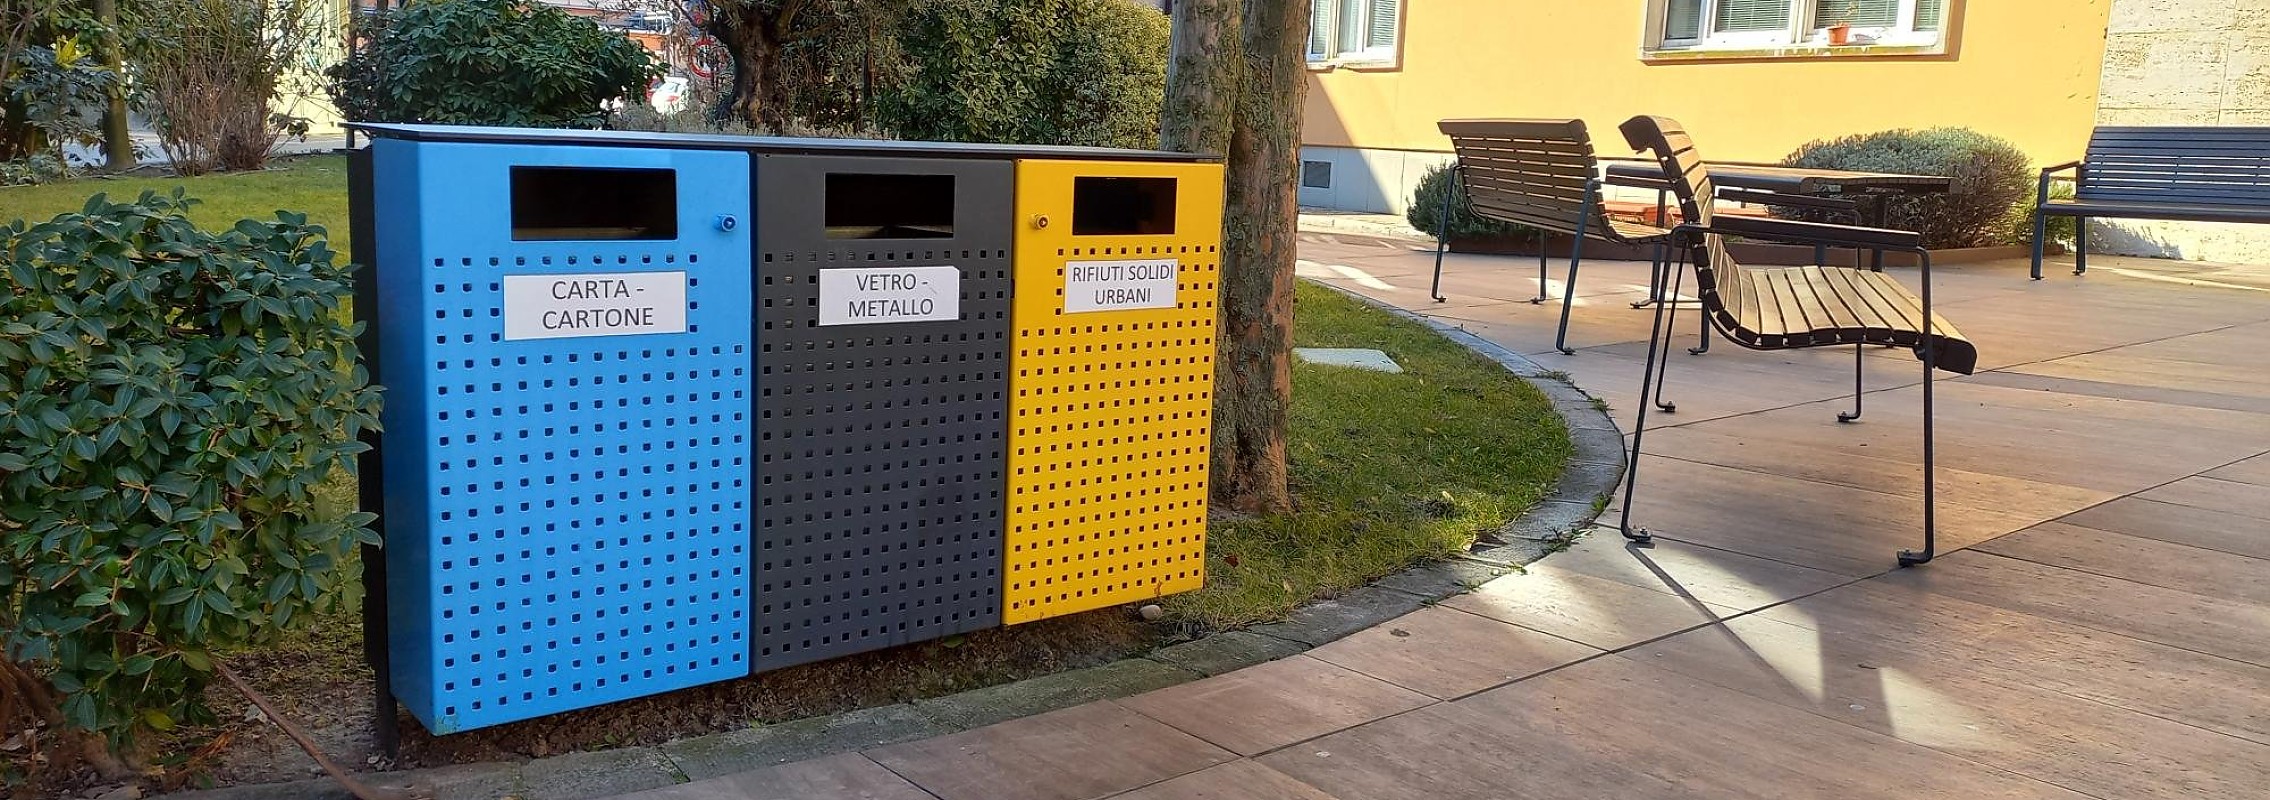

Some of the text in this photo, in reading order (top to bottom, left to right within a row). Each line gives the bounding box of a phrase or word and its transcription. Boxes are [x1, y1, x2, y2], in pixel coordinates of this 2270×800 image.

[855, 274, 917, 291] VETRO
[1073, 265, 1174, 282] RIFIUTI SOLIDI
[551, 280, 630, 300] CARTA
[1095, 288, 1151, 305] URBANI
[848, 298, 934, 318] METALLO
[542, 308, 654, 329] CARTONE
